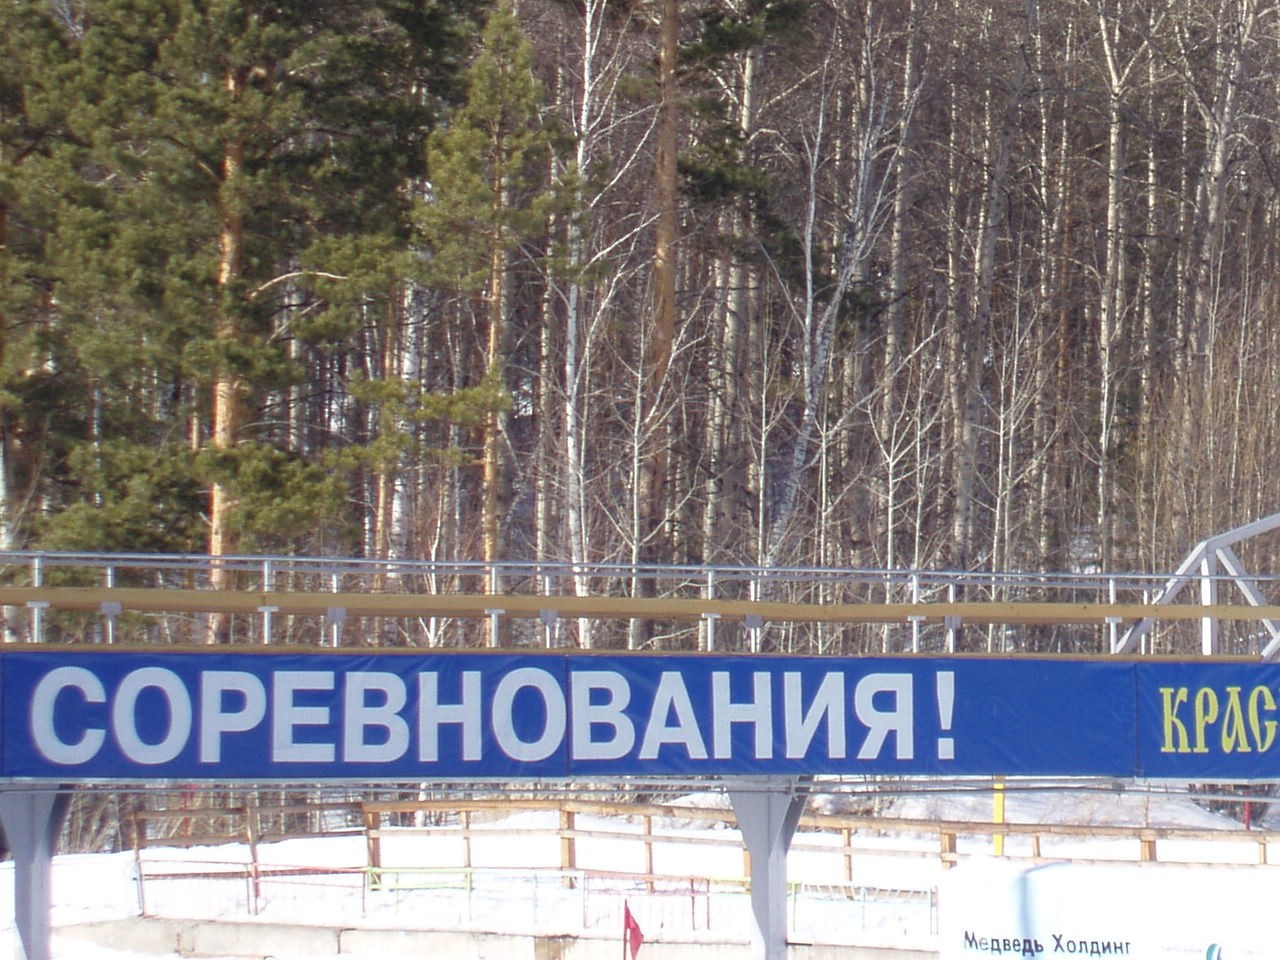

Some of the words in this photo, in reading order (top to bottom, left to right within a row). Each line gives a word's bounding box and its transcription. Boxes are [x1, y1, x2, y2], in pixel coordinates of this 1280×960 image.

[30, 666, 956, 765] СОРЕВНОВАНИЯ!
[964, 930, 1044, 957] Медведь
[1052, 934, 1131, 957] Холдинг
